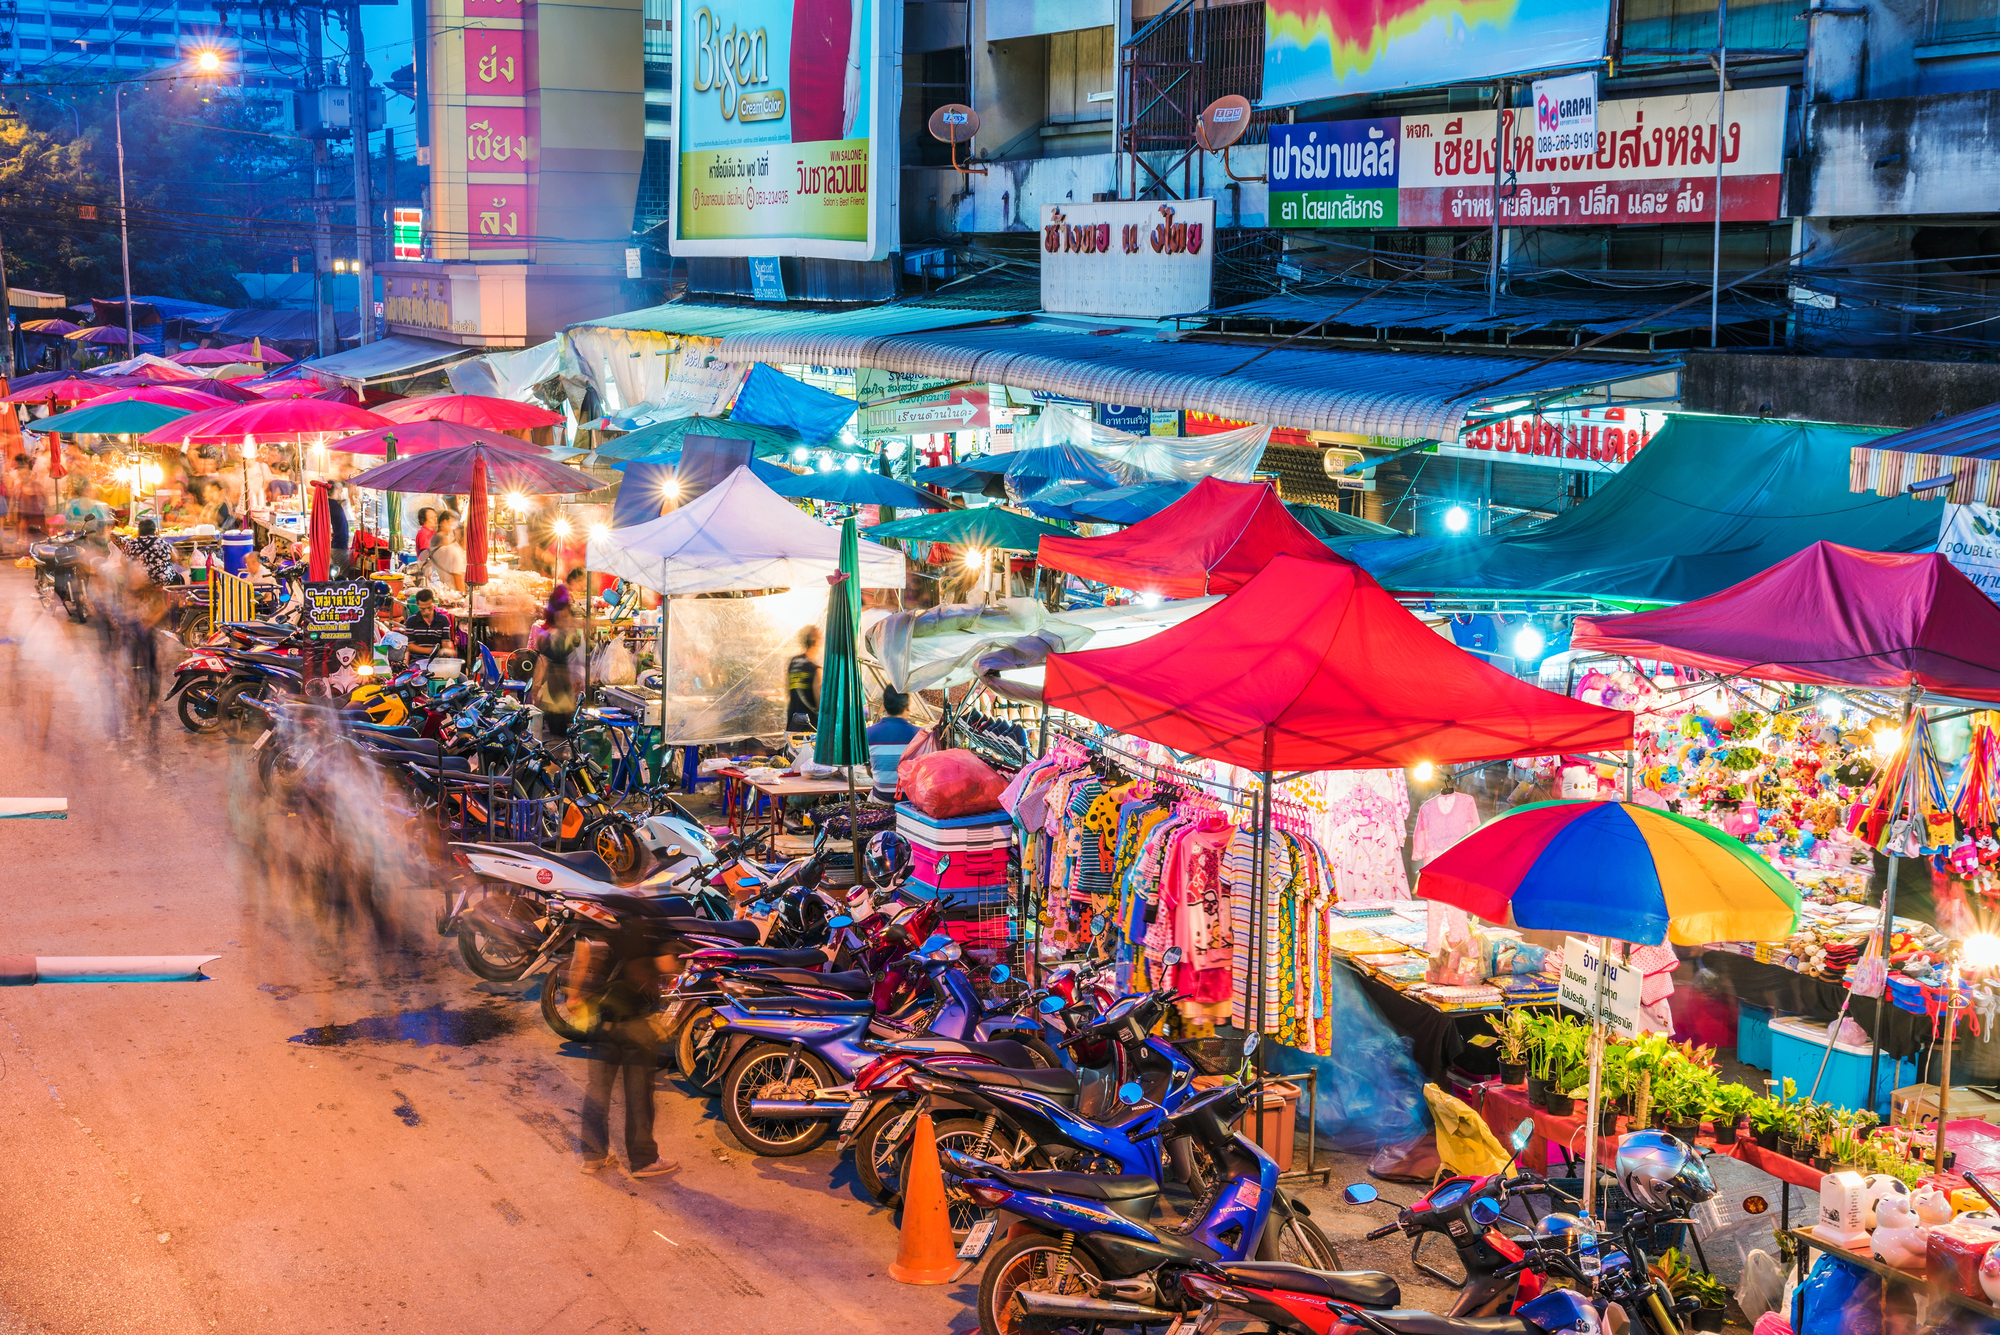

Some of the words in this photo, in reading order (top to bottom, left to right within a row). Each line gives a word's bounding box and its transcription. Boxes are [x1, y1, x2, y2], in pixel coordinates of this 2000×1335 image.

[478, 44, 515, 84] ย่ง
[693, 6, 768, 120] Bigen
[741, 99, 763, 115] Cream
[763, 97, 782, 112] Color
[467, 119, 527, 162] เชียง
[1405, 124, 1433, 139] หจก.
[1537, 131, 1593, 153] 088-266-9191
[1272, 126, 1396, 180] ฟาร์มาพลัส
[755, 190, 789, 205] 053-234935
[1281, 202, 1297, 220] ยา
[1302, 193, 1384, 220] โดยเภสัชกร
[1451, 186, 1570, 218] จำหนายสินค้า
[1579, 184, 1619, 216] ปลีก
[1628, 193, 1668, 215] และ
[1676, 183, 1704, 214] ส่ง
[479, 197, 518, 238] ล้ง
[1945, 541, 1994, 558] DOUBLE
[1131, 1102, 1154, 1112] HONDA
